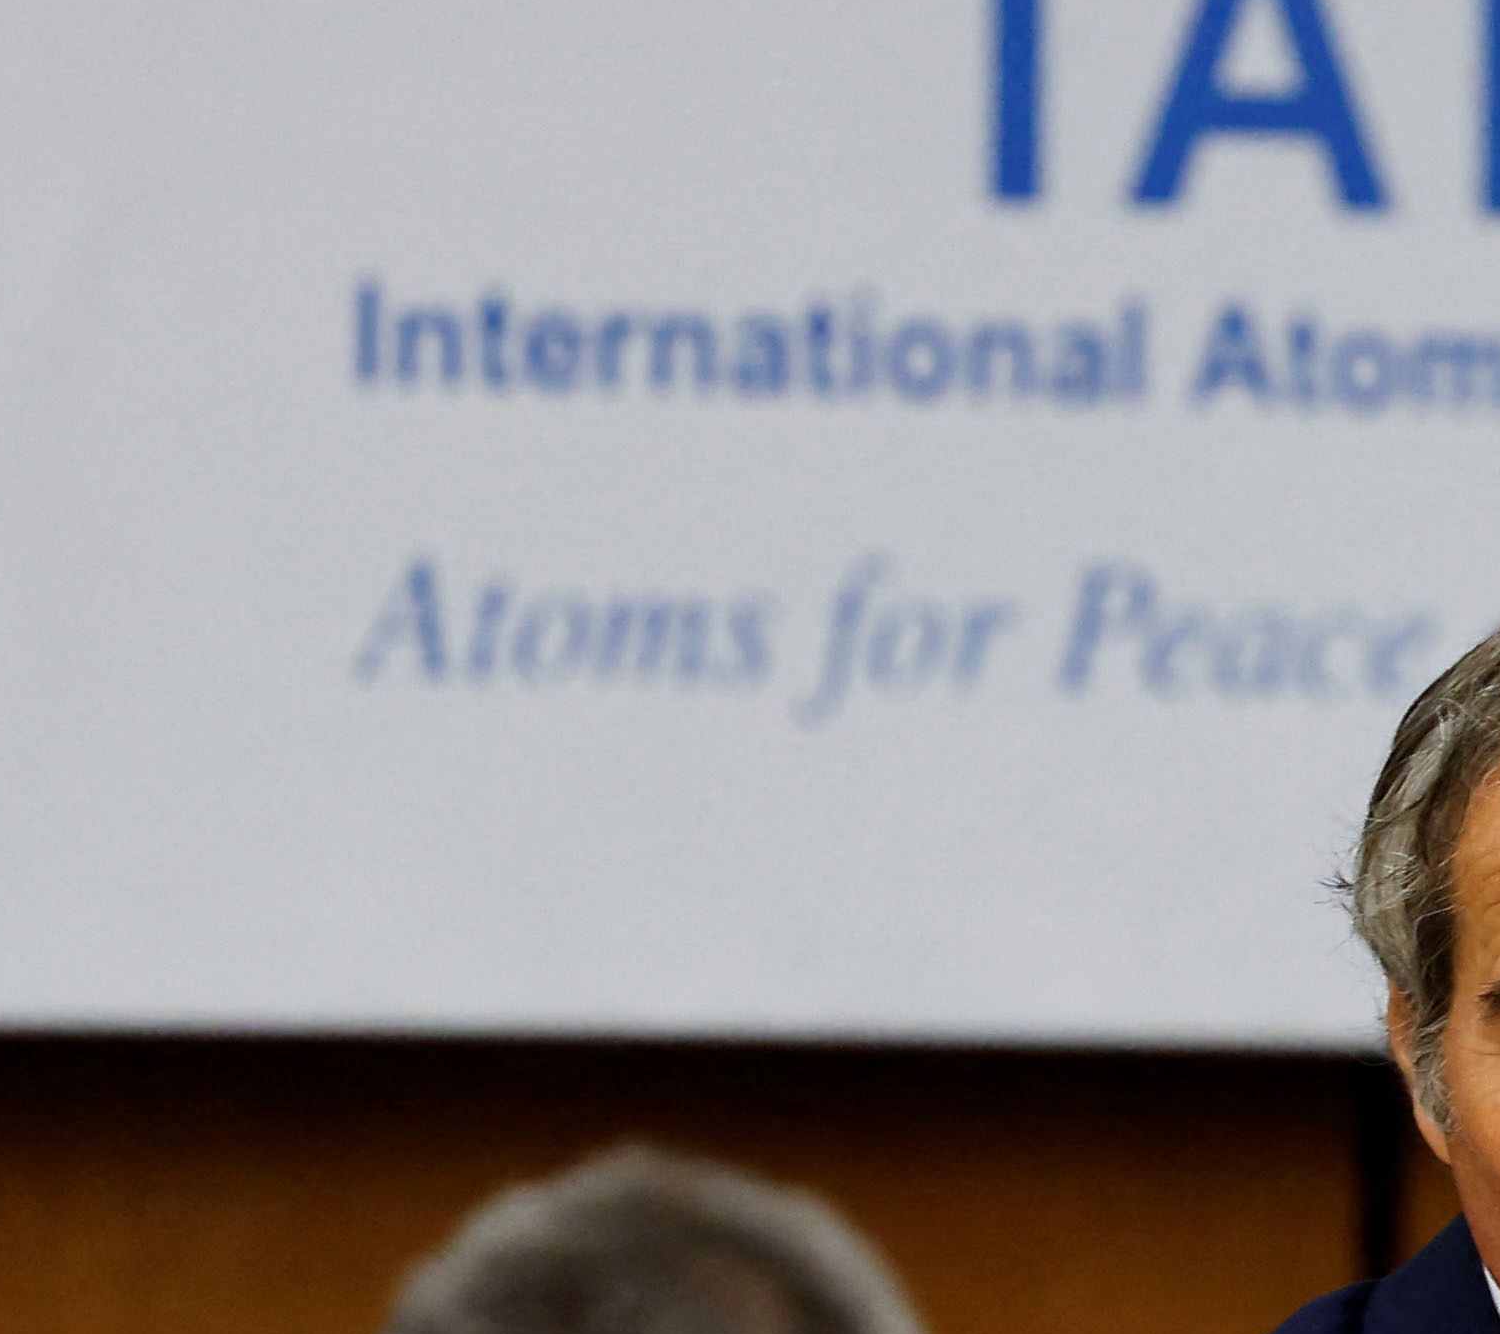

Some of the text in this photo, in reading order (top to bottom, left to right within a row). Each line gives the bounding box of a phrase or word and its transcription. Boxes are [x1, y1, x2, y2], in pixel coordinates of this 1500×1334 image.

[353, 279, 1150, 407] International
[355, 556, 772, 683] Atoms
[788, 553, 1015, 729] for
[1058, 553, 1436, 697] Peace
